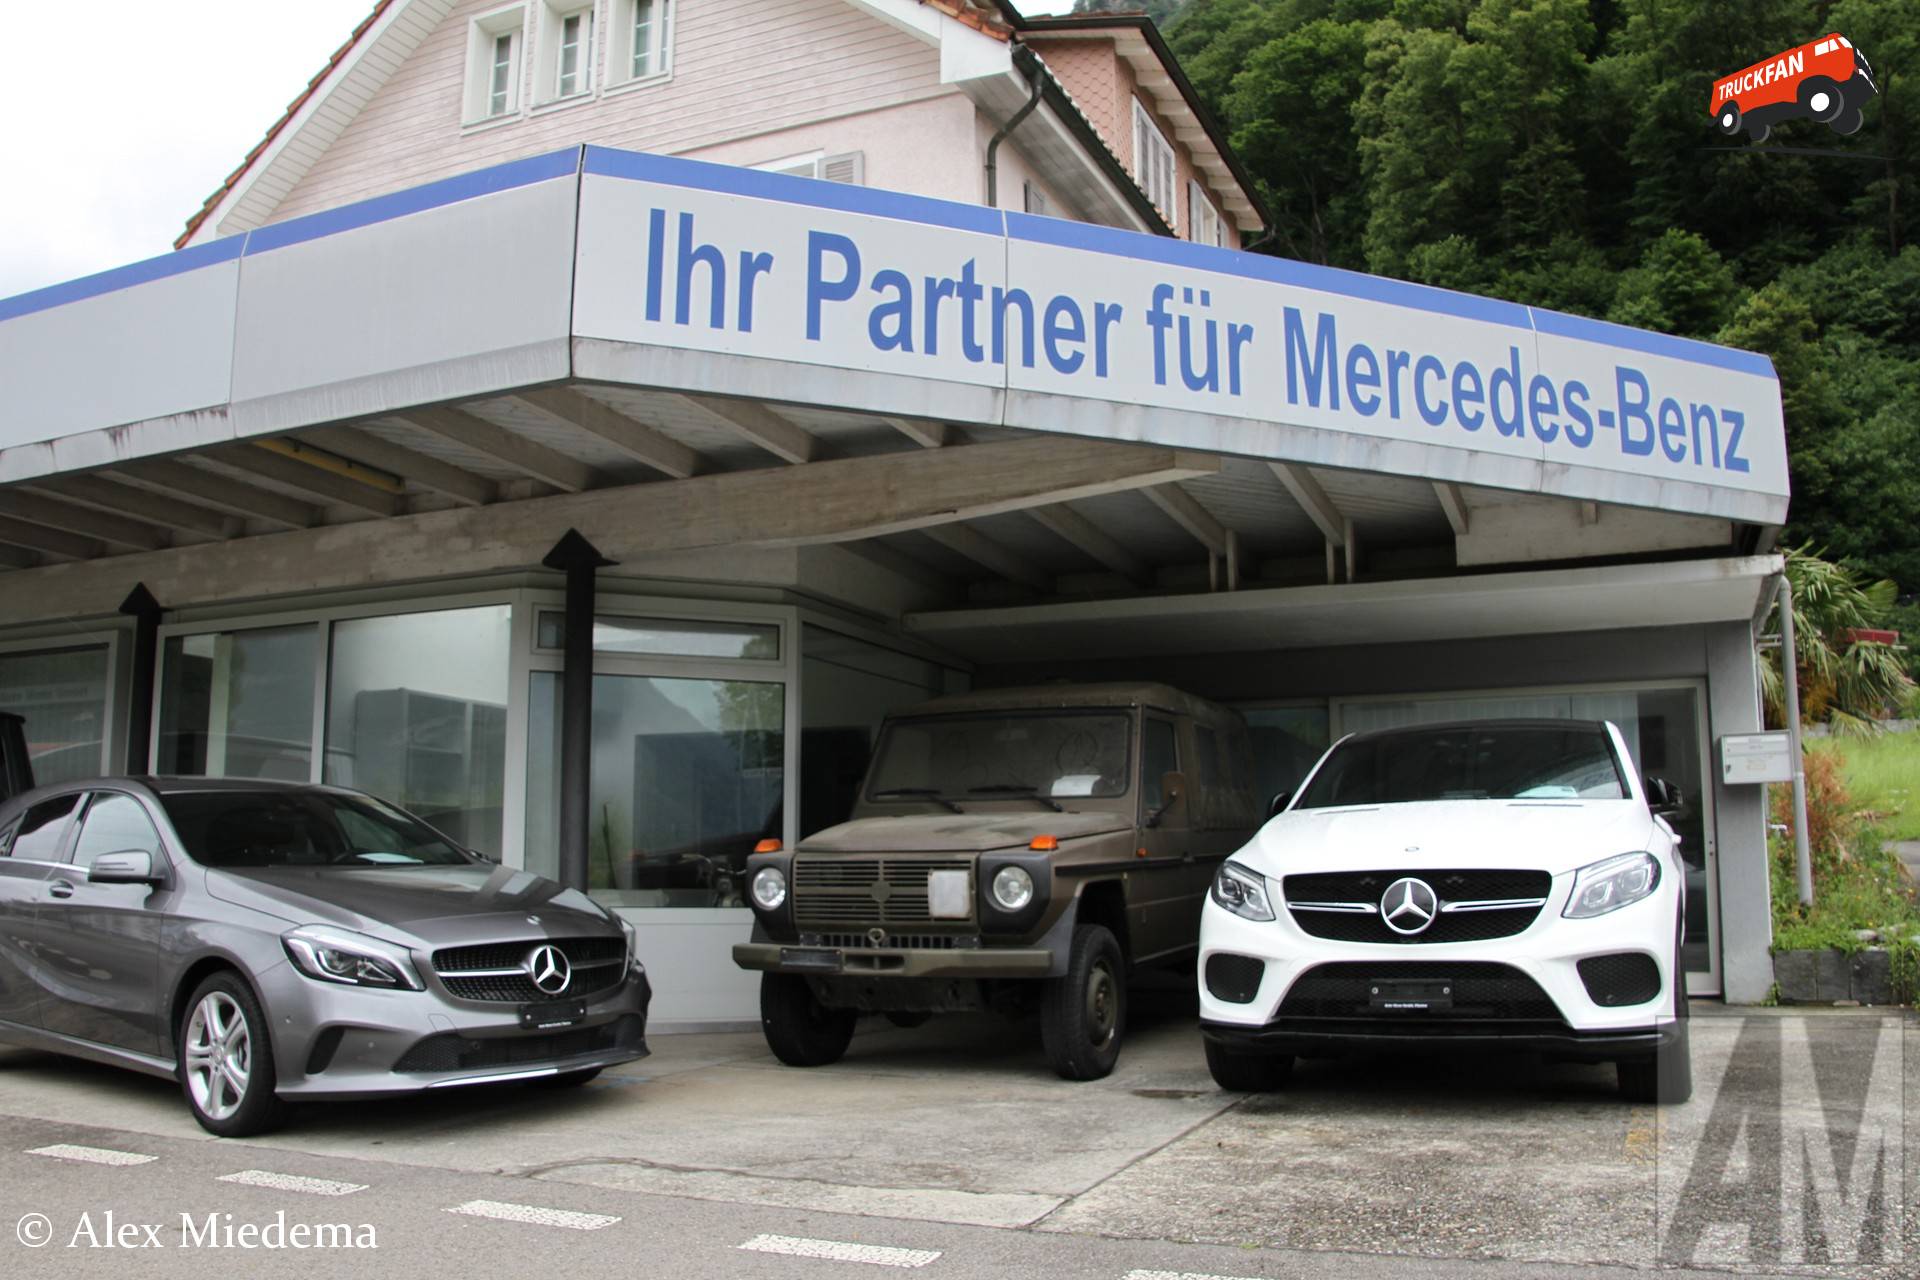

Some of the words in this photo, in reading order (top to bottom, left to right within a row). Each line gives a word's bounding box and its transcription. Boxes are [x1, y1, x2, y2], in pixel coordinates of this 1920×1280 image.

[645, 207, 774, 333] Ihr
[805, 229, 1123, 378] Partner
[1146, 283, 1254, 396] für
[1282, 306, 1751, 473] Mercedes-Benz
